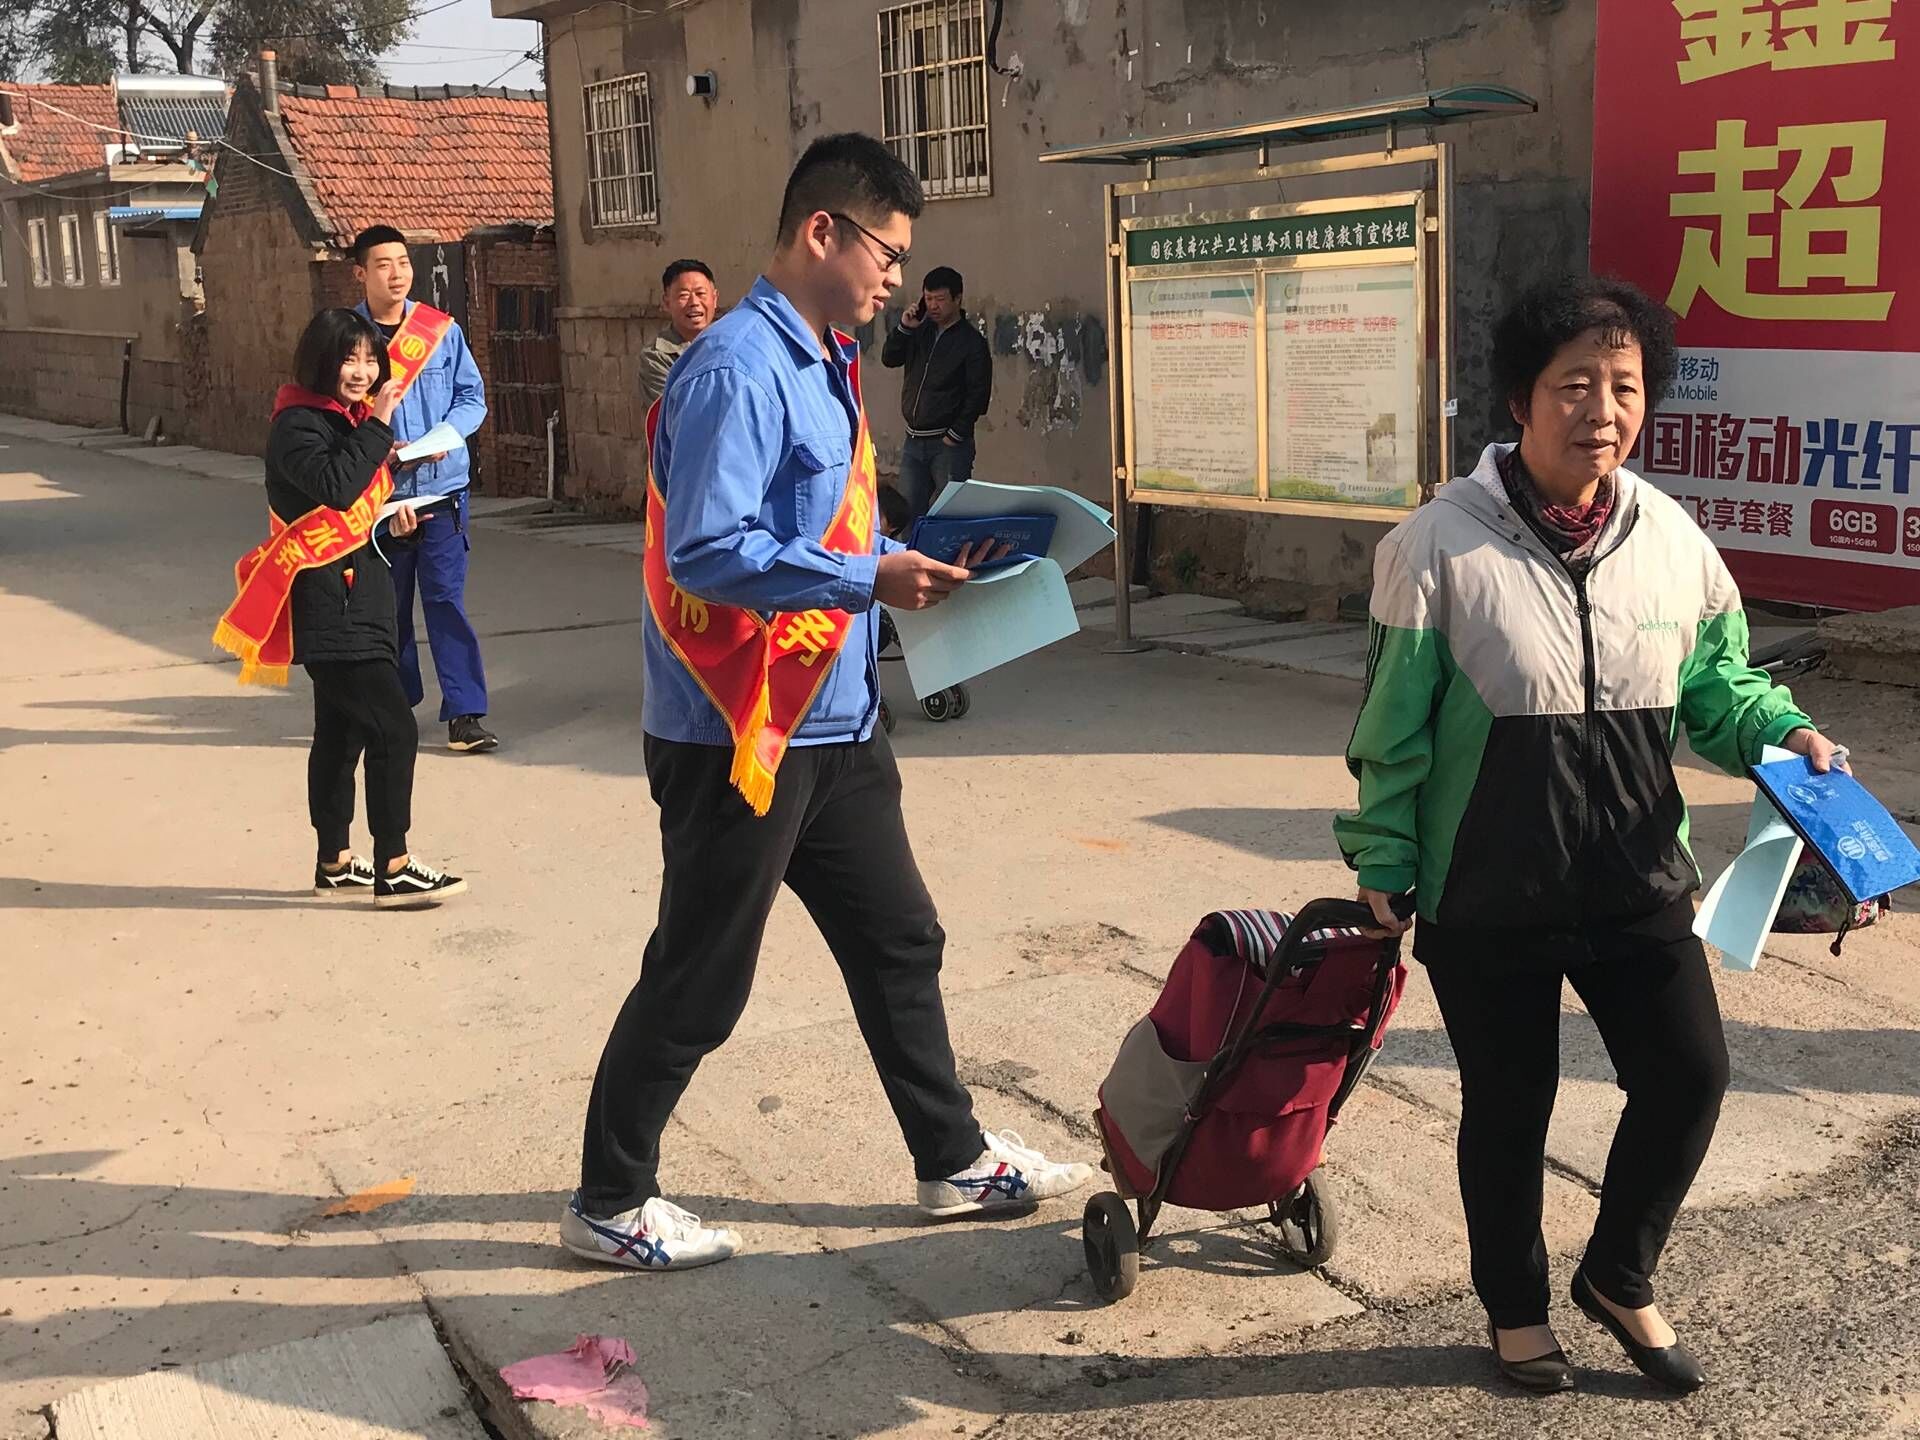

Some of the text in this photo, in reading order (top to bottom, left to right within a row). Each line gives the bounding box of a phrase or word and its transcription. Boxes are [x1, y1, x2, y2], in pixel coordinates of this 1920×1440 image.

[1673, 356, 1720, 382] 移动
[1677, 385, 1718, 401] Mobile
[1626, 413, 1920, 494] 国移动光纤
[1671, 494, 1794, 538] 飞享套餐
[1829, 508, 1878, 535] 6GB
